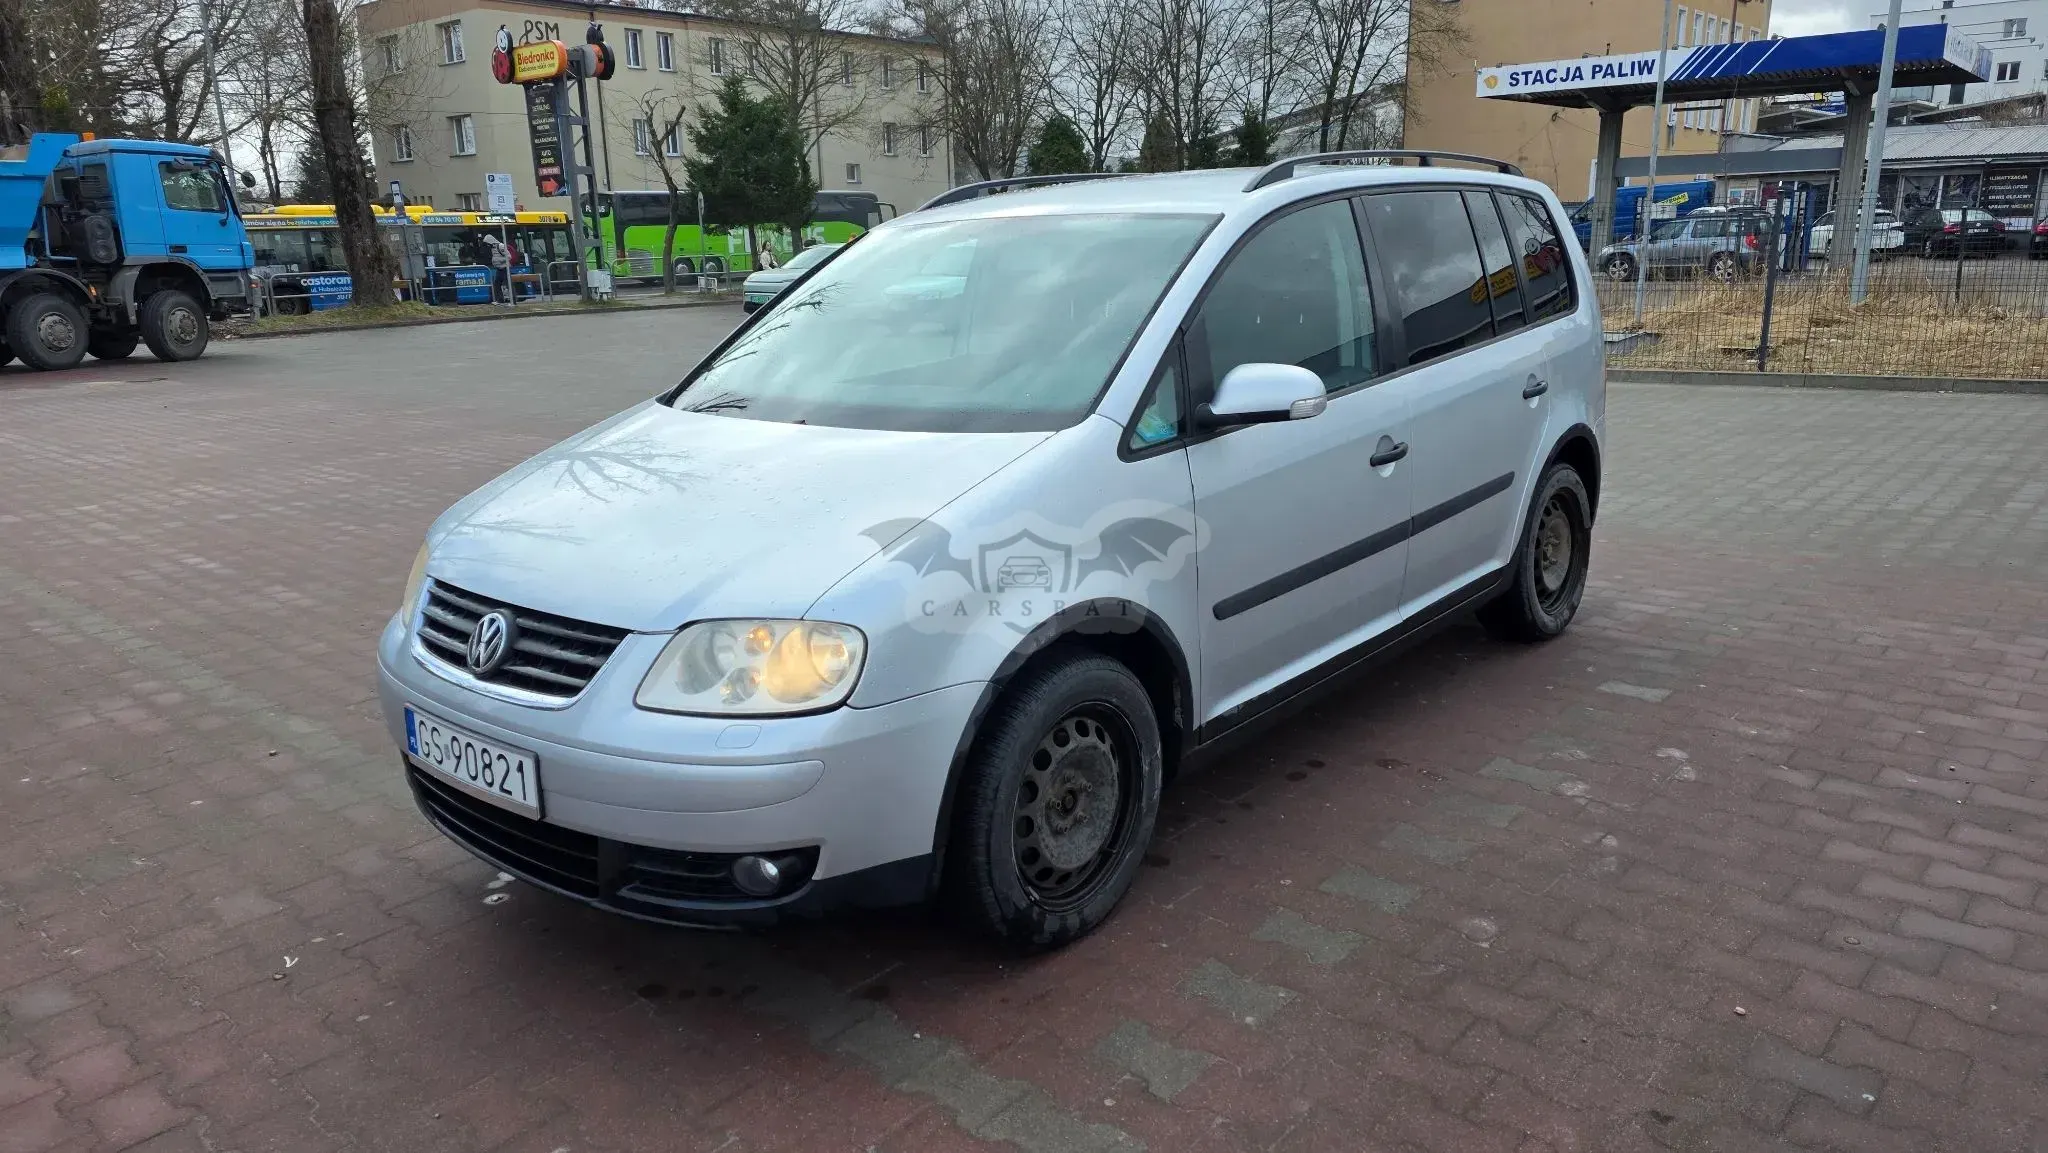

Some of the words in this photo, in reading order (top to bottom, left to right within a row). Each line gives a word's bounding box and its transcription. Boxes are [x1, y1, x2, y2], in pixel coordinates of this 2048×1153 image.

[519, 20, 560, 46] PSM
[517, 49, 554, 65] Biedronka
[1509, 66, 1584, 87] STACJA
[1591, 59, 1656, 79] PALIW
[417, 720, 444, 765] GS
[451, 736, 527, 802] 90821
